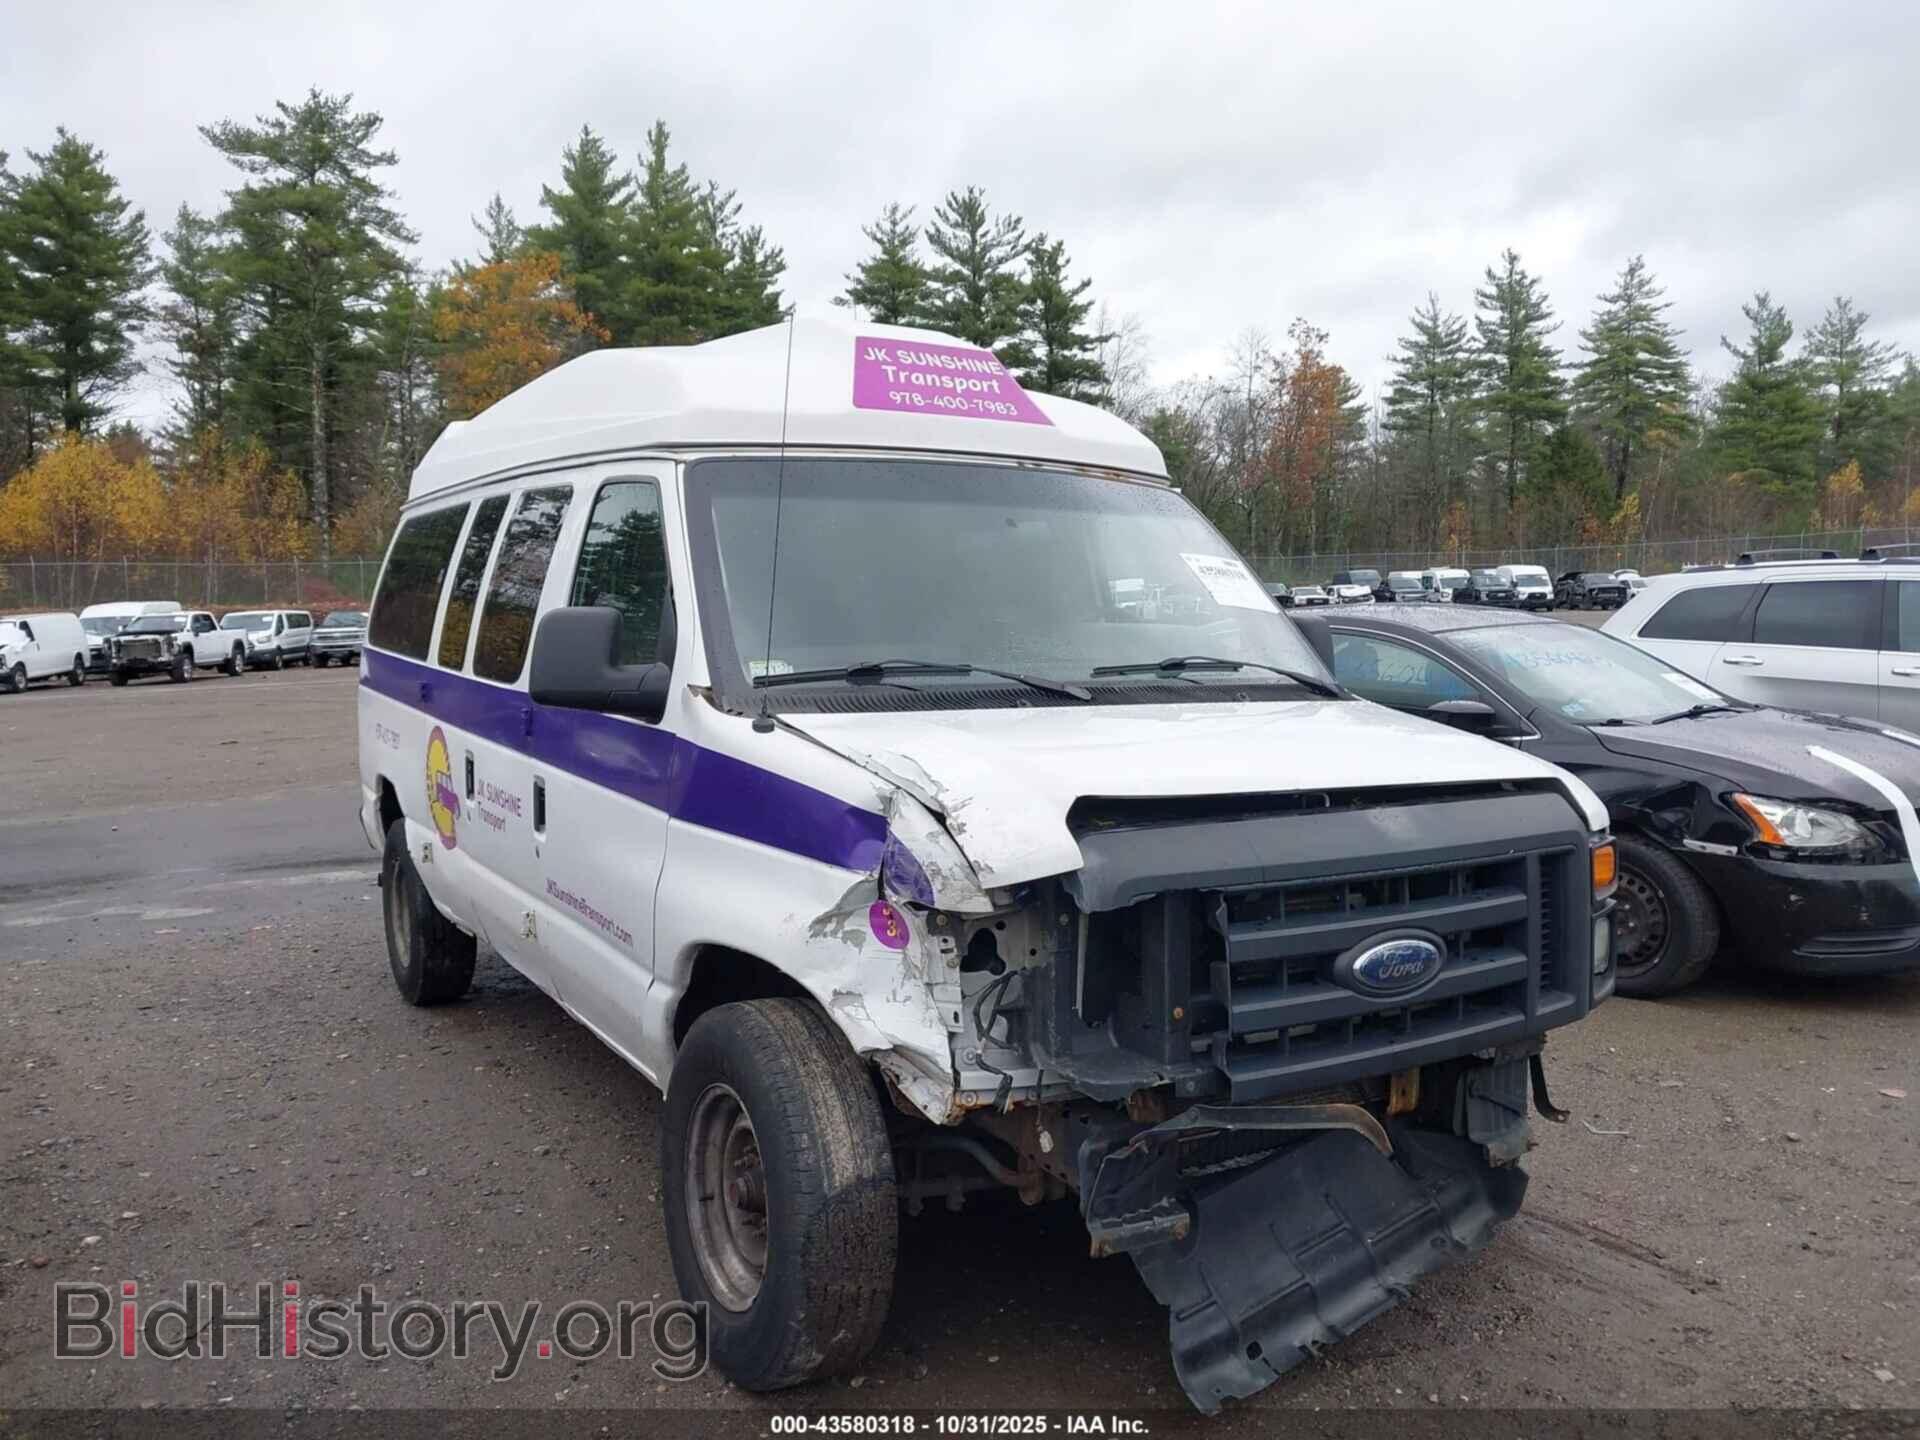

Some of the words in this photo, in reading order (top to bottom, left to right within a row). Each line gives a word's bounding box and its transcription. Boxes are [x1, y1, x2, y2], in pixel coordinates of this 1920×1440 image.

[864, 347, 893, 363] JK
[897, 350, 1005, 377] SUNSHINE
[881, 365, 1001, 394] Transport
[889, 391, 1019, 416] 978-400-7983
[487, 783, 523, 817] SUNSHINE
[478, 801, 506, 832] Transport
[1375, 944, 1425, 980] Ford
